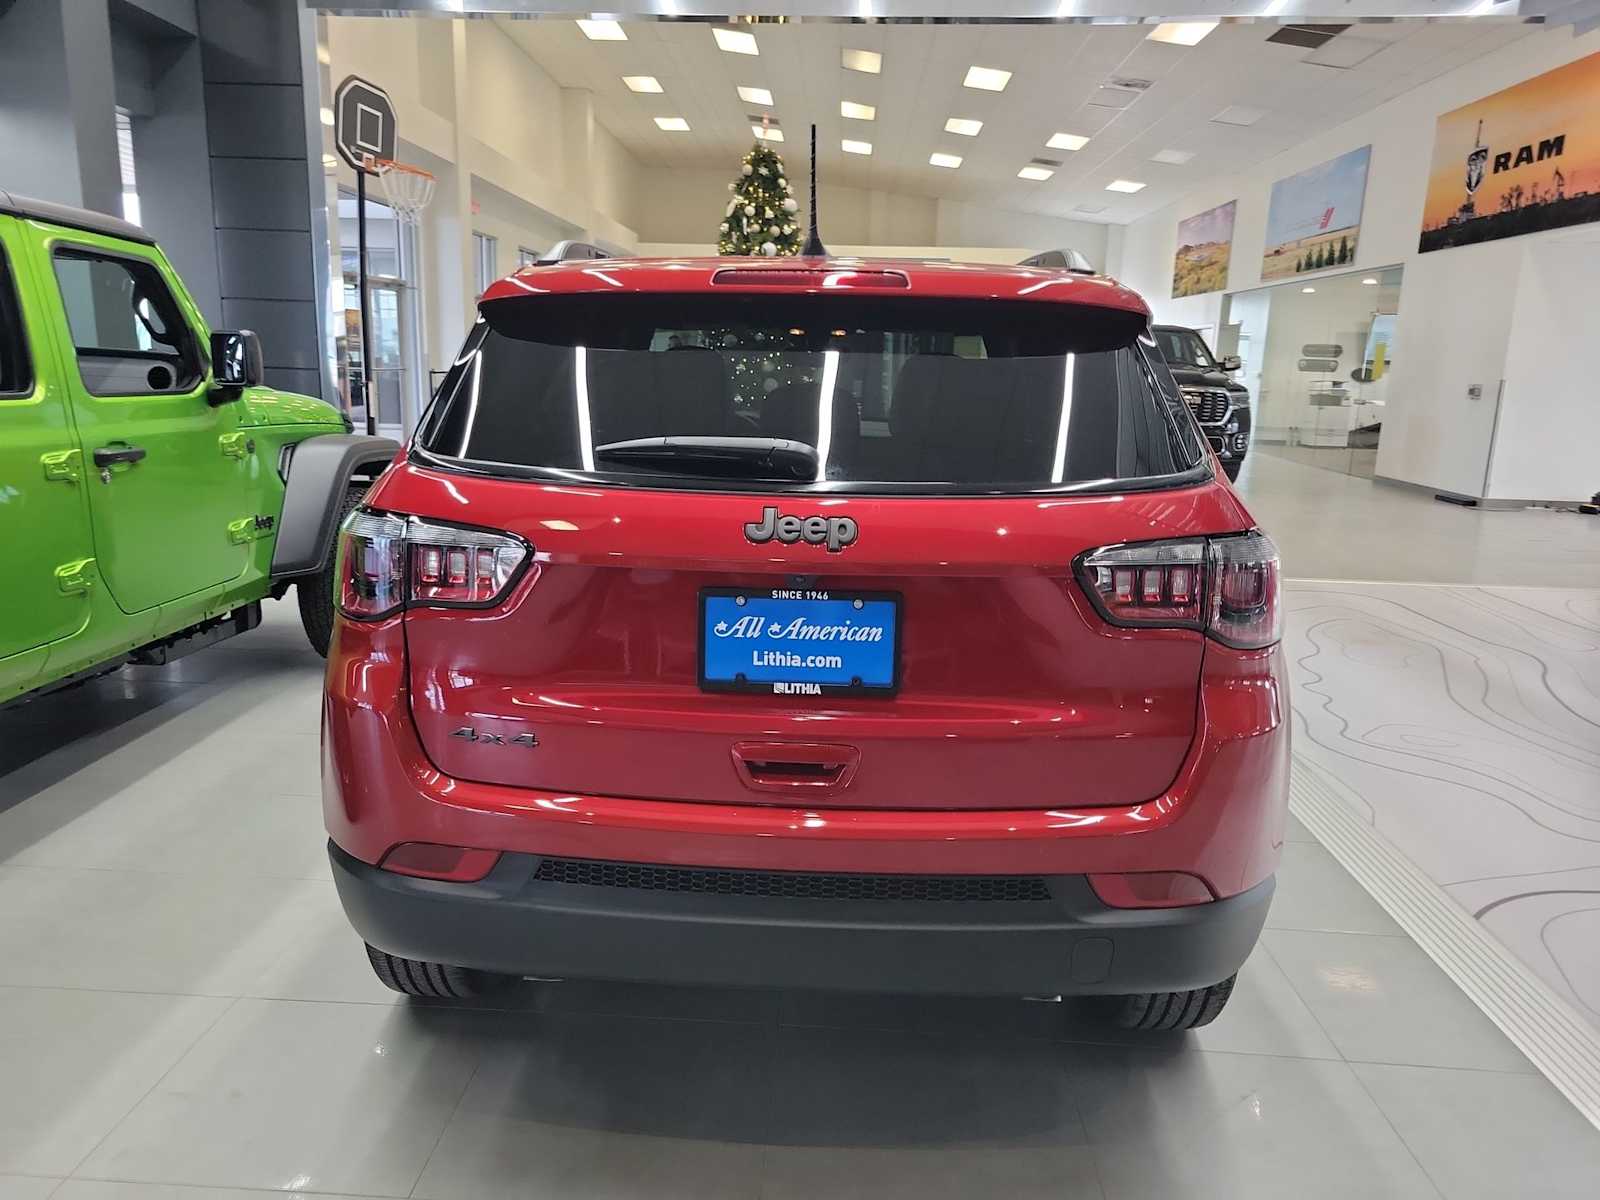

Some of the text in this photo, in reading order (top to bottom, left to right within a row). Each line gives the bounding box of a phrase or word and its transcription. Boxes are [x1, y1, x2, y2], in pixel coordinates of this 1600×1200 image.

[1493, 134, 1566, 174] RAM
[744, 507, 858, 552] Jeep
[772, 590, 829, 600] SINCE 1946
[714, 616, 883, 642] All American
[753, 651, 842, 669] Lithia.com
[784, 682, 822, 695] LITHIA
[448, 727, 540, 748] 4x4
